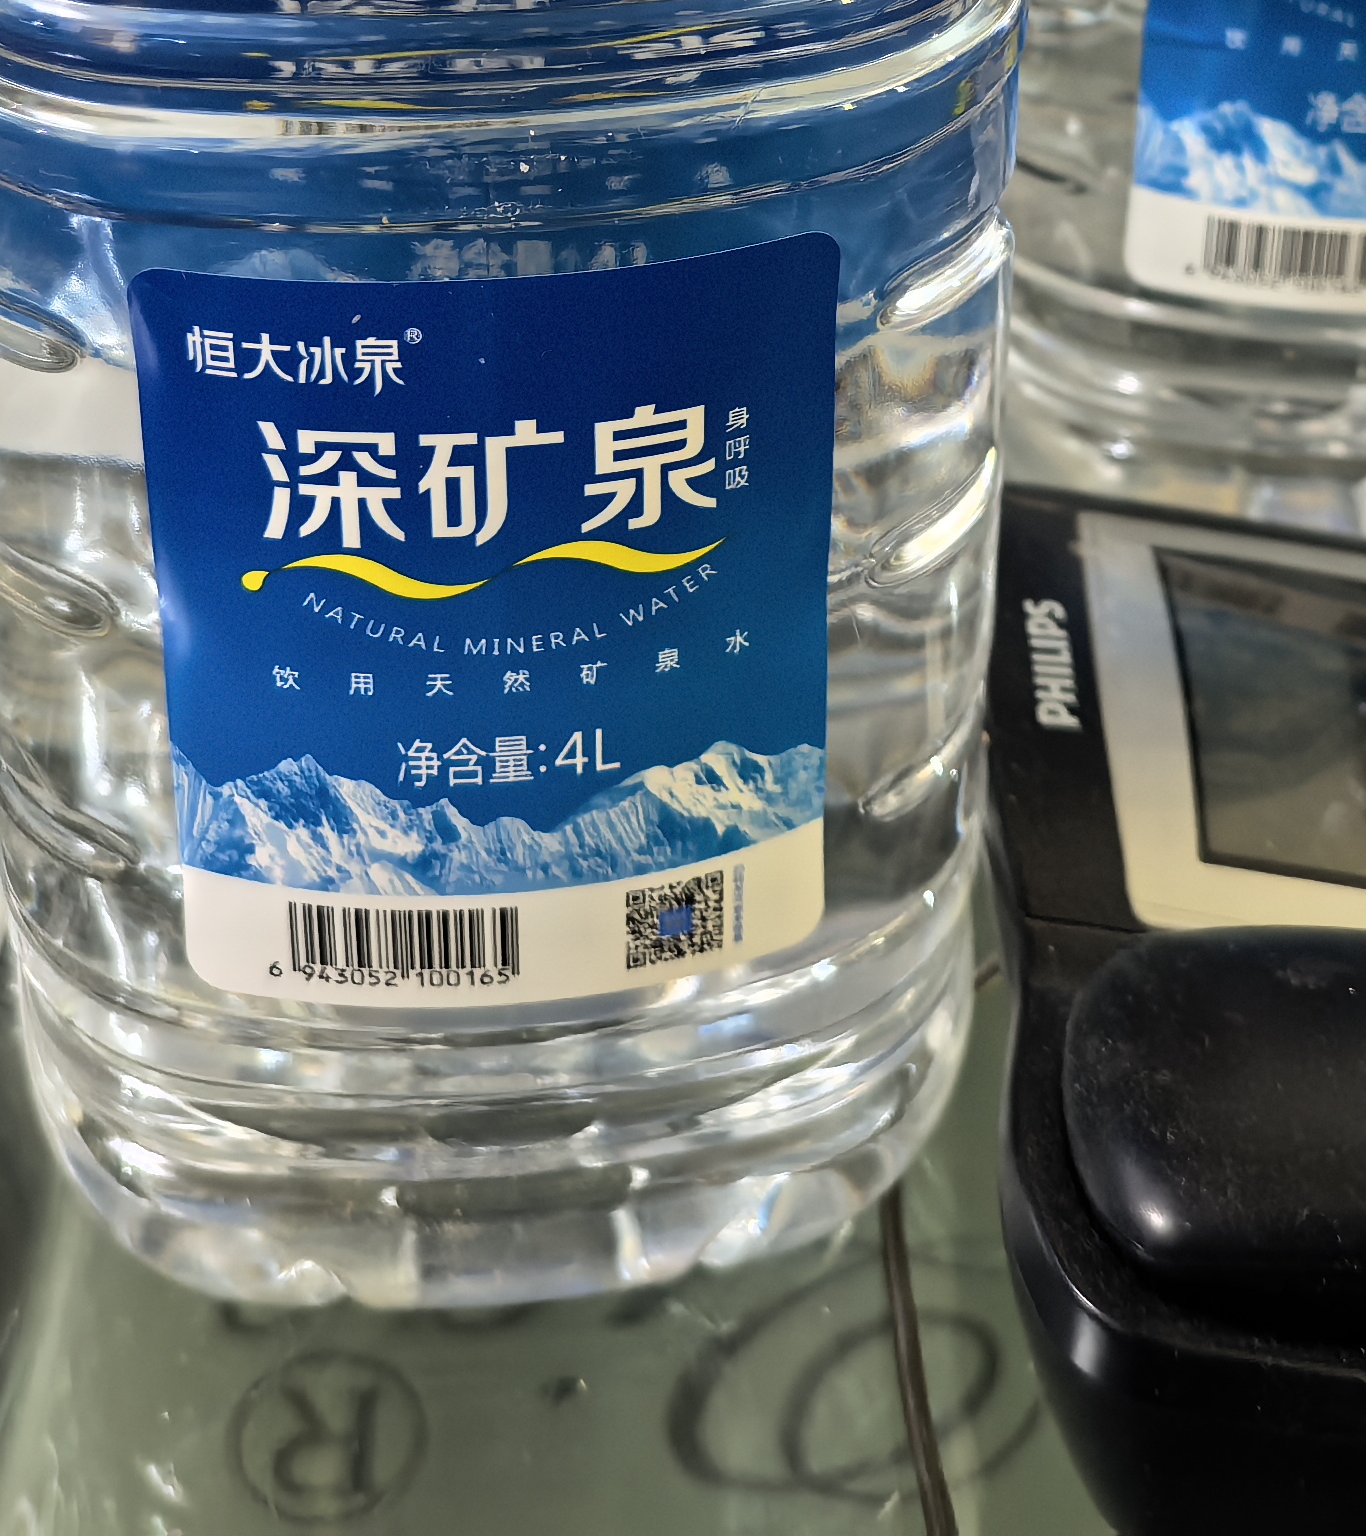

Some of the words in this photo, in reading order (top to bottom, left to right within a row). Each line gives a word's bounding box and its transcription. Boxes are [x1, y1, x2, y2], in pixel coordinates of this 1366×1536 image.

[186, 324, 404, 396] 恒大冰泉
[257, 403, 718, 548] 深矿泉
[726, 407, 750, 490] 身呼吸
[302, 592, 445, 654] NATURAL
[463, 622, 607, 656] MINERAL
[620, 563, 719, 627] WATER
